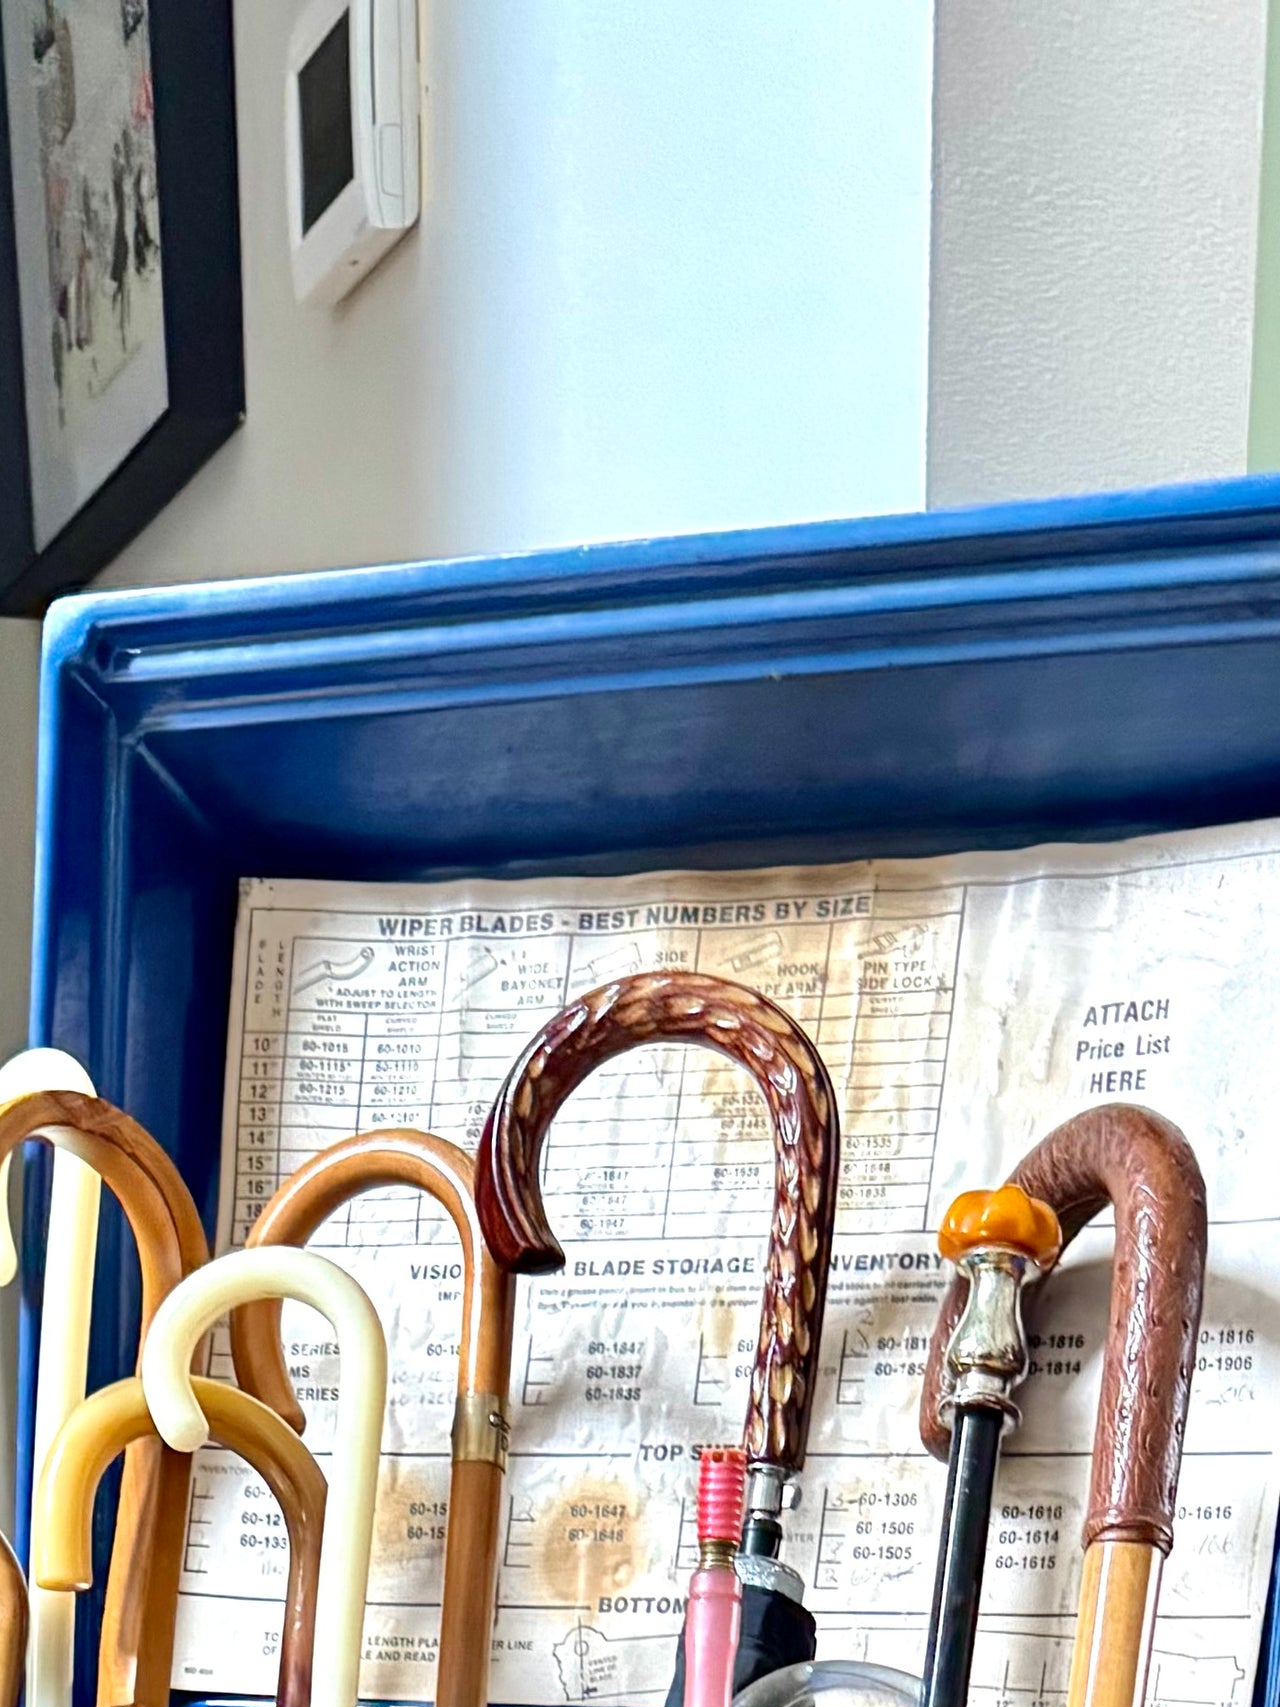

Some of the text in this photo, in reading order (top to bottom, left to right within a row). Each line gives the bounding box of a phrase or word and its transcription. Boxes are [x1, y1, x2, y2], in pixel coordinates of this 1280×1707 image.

[378, 917, 453, 937] WIPER
[459, 913, 554, 934] BLADES
[578, 910, 639, 931] BEST
[646, 903, 766, 926] NUMBERS
[775, 901, 807, 919] BY
[816, 896, 871, 917] SIZE
[394, 945, 436, 957] WRIST
[656, 951, 689, 963] SIDE
[388, 961, 440, 972] ACTION
[863, 961, 927, 975] PIN TYPE
[398, 977, 428, 987] ARM
[893, 976, 932, 988] LOCK
[1082, 998, 1170, 1028] ATTACH
[1076, 1034, 1171, 1062] Price List
[1089, 1068, 1147, 1094] HERE
[410, 1263, 462, 1280] VISIO
[574, 1259, 646, 1277] BLADE
[651, 1257, 755, 1276] STORAGE
[829, 1251, 942, 1271] NVENTORY
[877, 1335, 928, 1350] 60-181
[1029, 1334, 1085, 1349] 0-1816
[1200, 1329, 1255, 1345] 0-1816
[875, 1361, 926, 1376] 60-185
[1028, 1361, 1081, 1376] 0-1814
[1198, 1355, 1254, 1371] 0-1906
[296, 1387, 340, 1401] ERIES
[640, 1444, 684, 1461] TOP
[1001, 1505, 1063, 1520] 60-1616
[1178, 1506, 1232, 1520] 0-1616
[856, 1521, 915, 1535] 601506
[239, 1534, 287, 1550] 60-133
[999, 1530, 1060, 1545] 60-1614
[852, 1546, 913, 1560] 60-1505
[995, 1555, 1057, 1571] 60-1615
[598, 1596, 687, 1614] BOTTOM
[368, 1636, 415, 1648] LENGTH
[507, 1640, 534, 1651] LINE
[375, 1650, 401, 1661] AND
[403, 1652, 436, 1663] READ
